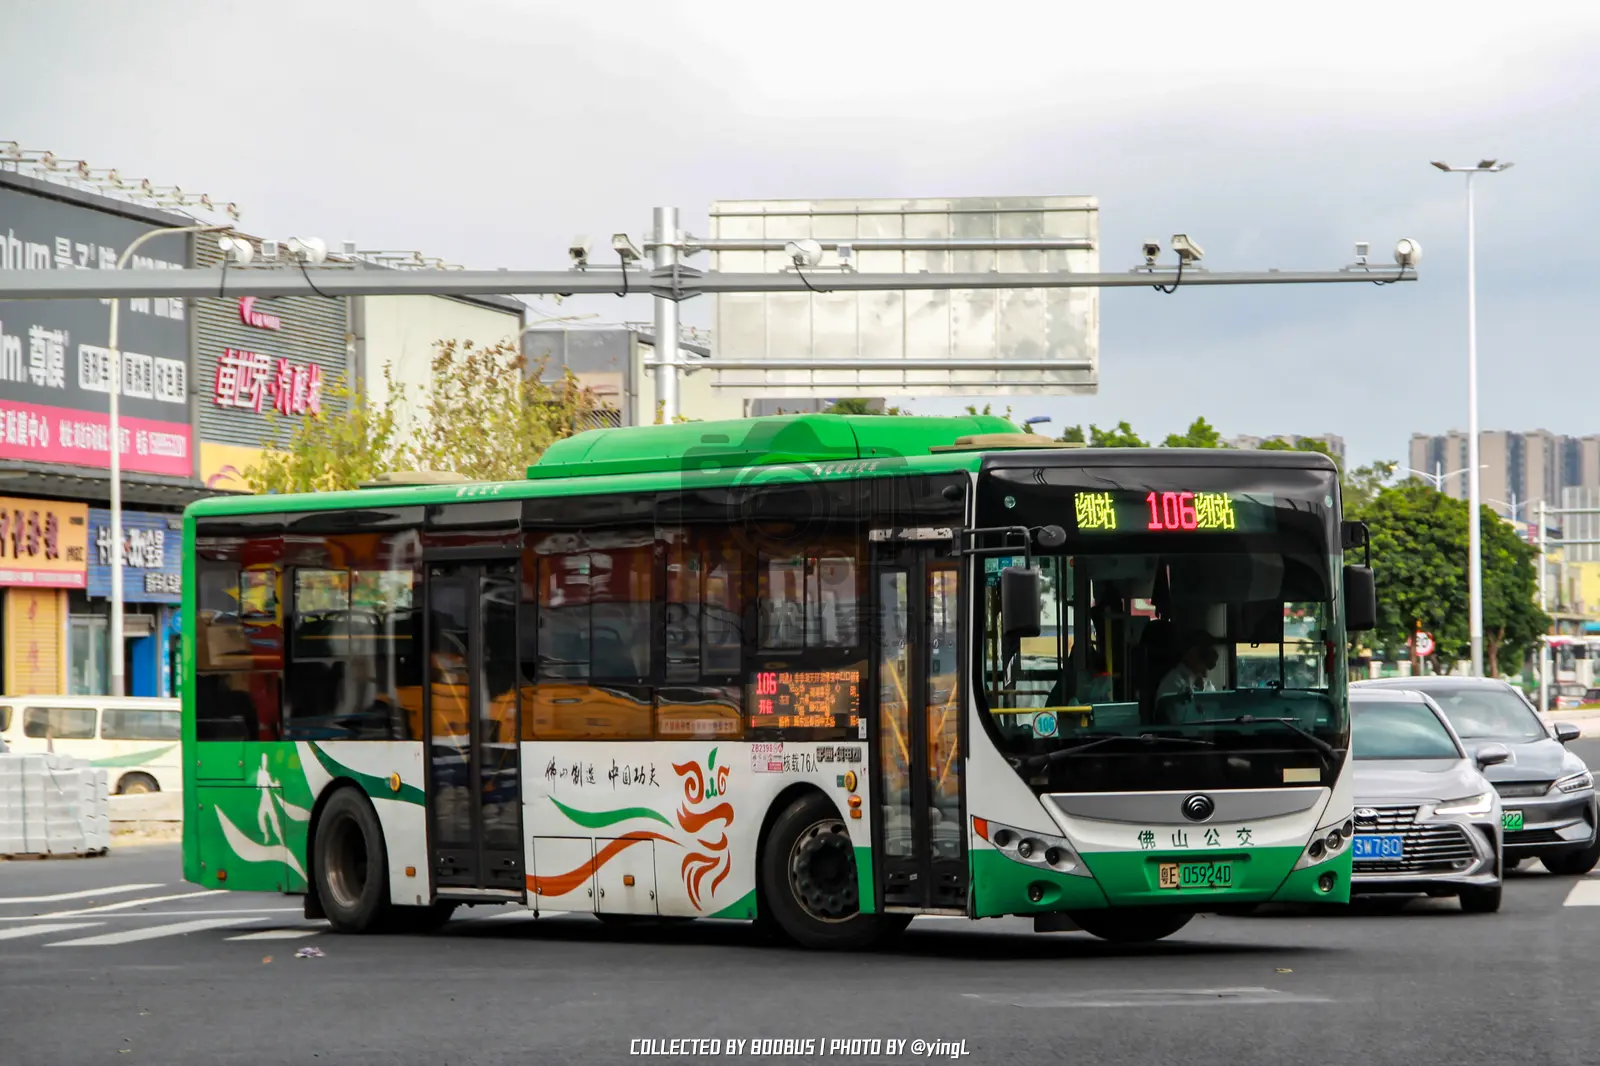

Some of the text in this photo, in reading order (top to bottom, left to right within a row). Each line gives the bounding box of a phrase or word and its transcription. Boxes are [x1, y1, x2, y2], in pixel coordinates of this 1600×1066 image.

[1146, 491, 1197, 530] 106
[756, 671, 778, 695] 106
[782, 753, 819, 773] 核载76人
[1137, 827, 1255, 850] 佛山公交
